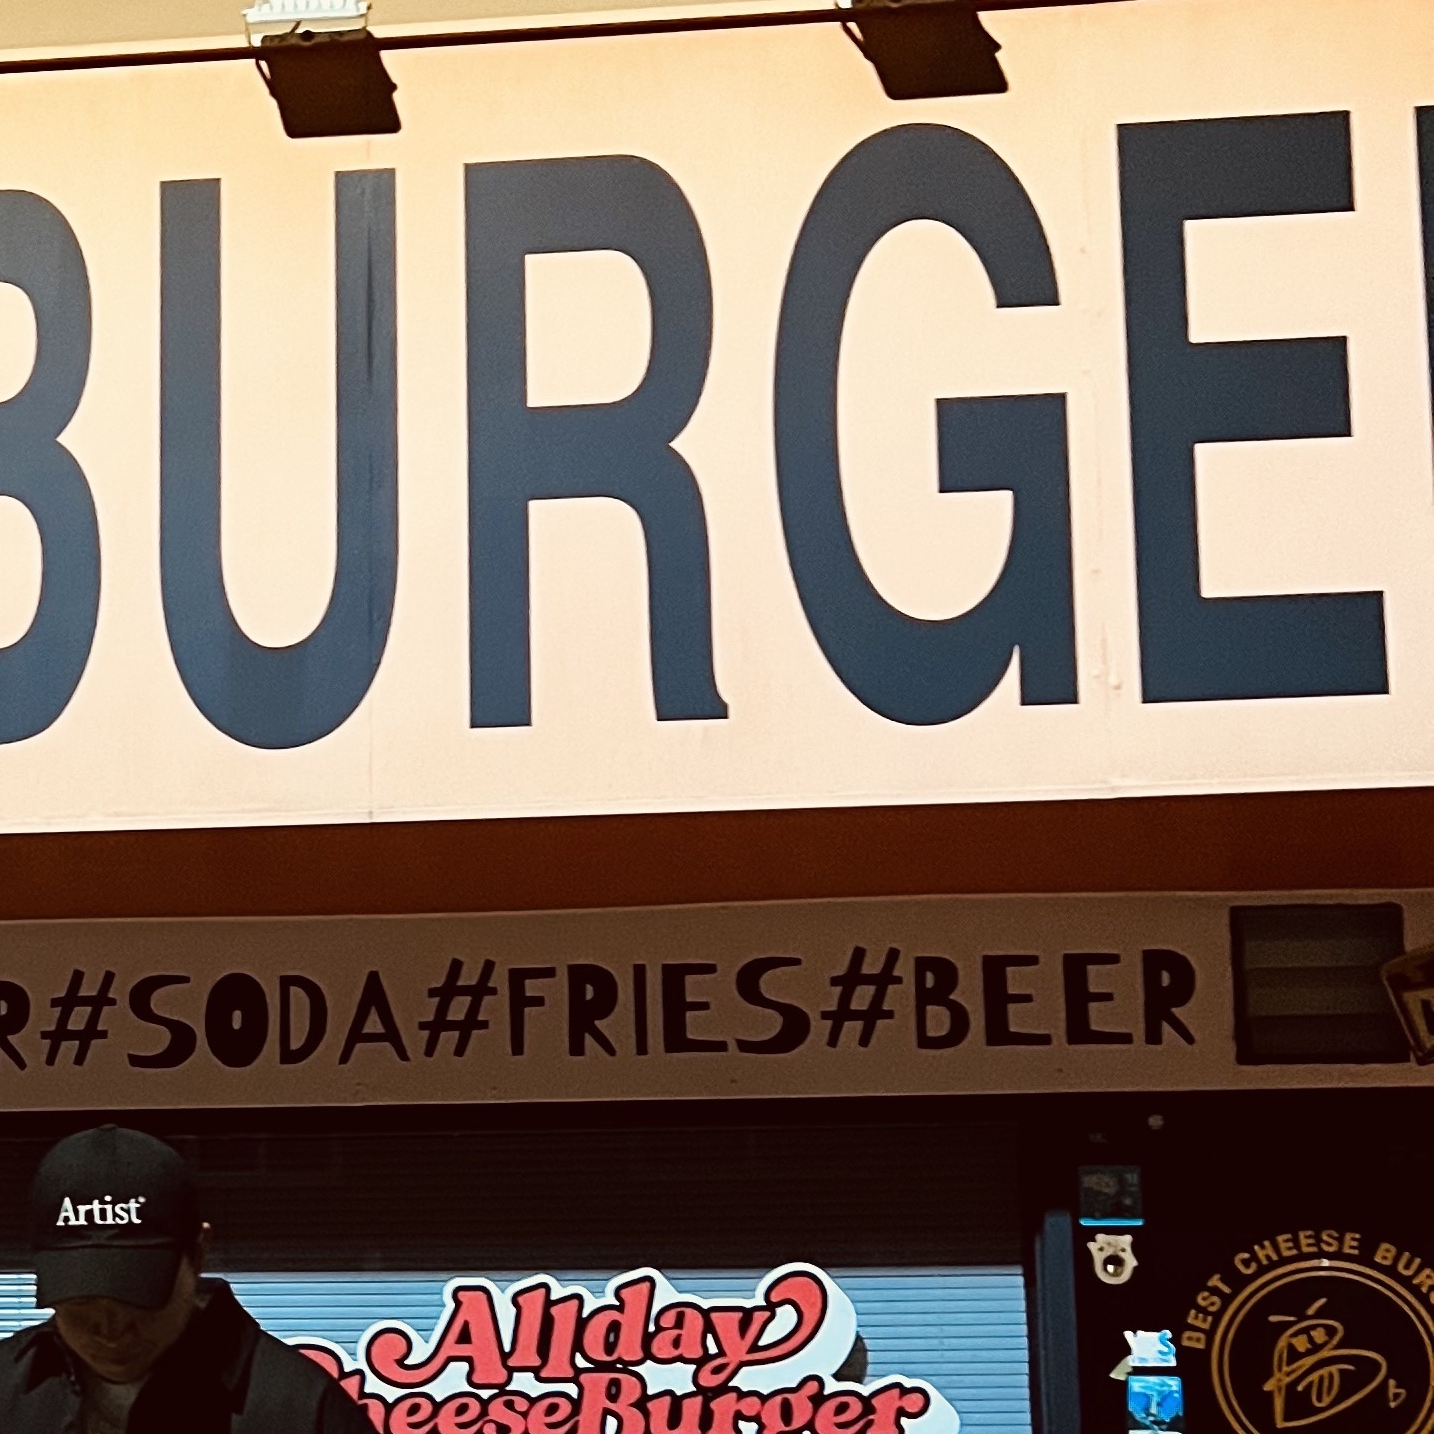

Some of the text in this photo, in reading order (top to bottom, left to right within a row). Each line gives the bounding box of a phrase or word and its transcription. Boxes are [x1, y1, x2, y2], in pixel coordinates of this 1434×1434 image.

[365, 1270, 828, 1388] Allday
[1180, 1273, 1233, 1350] BEST
[1233, 1230, 1362, 1275] CHEESE
[1373, 1242, 1434, 1305] BUR
